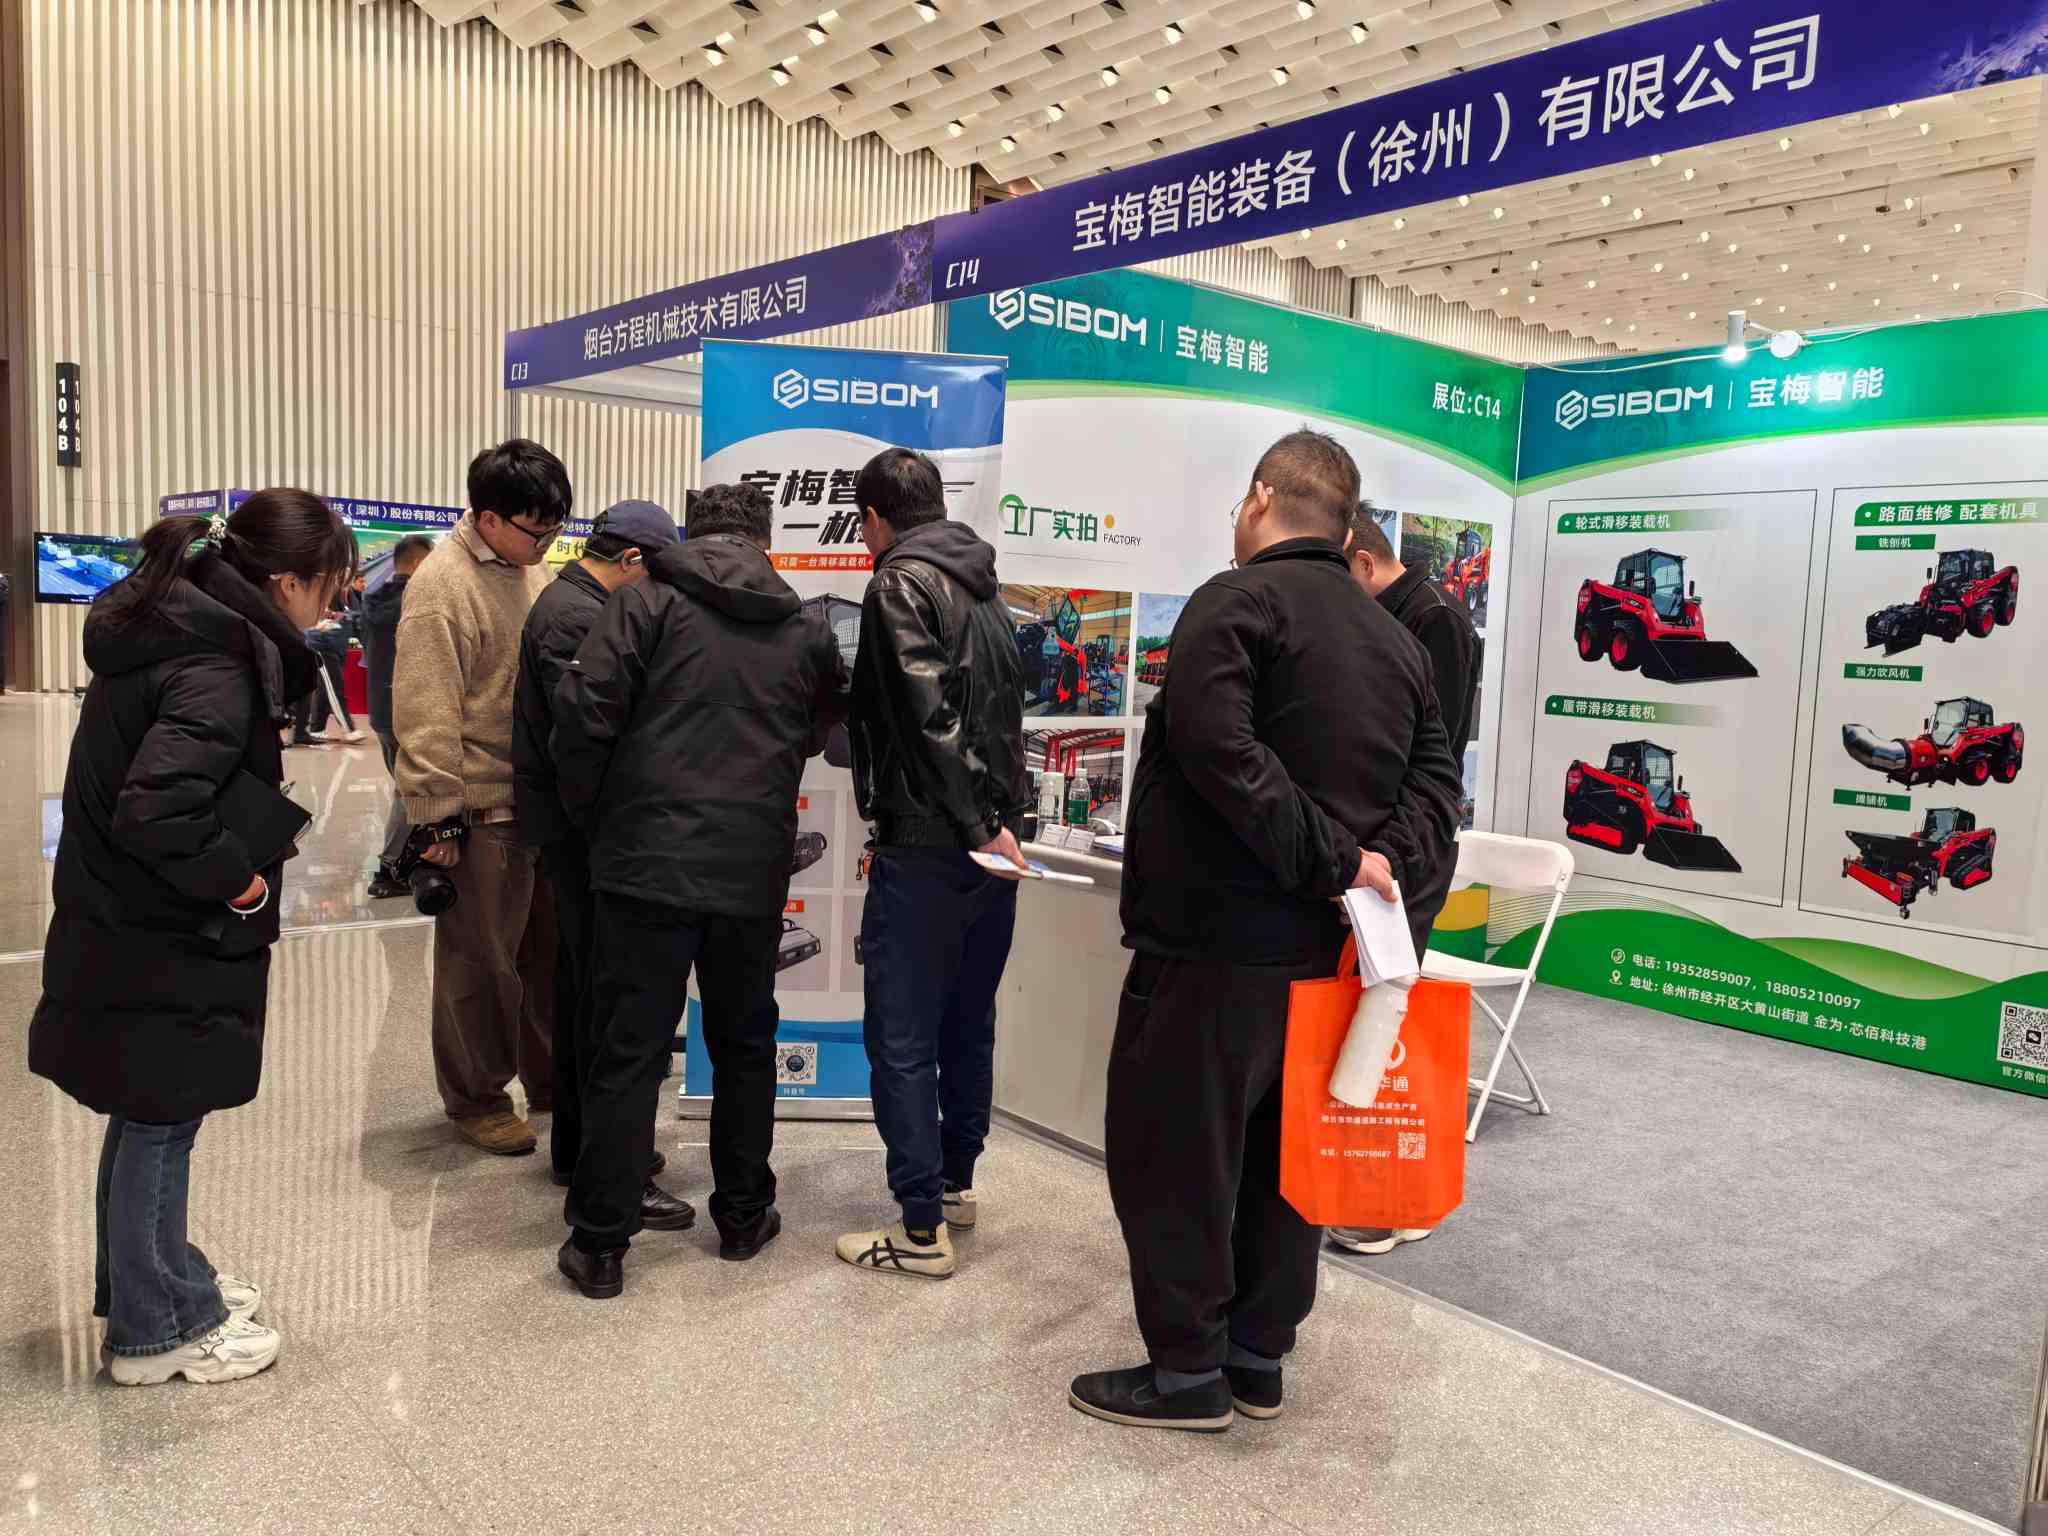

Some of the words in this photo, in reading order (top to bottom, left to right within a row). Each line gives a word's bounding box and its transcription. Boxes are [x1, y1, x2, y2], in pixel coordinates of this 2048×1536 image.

[1072, 14, 1821, 251] 宝梅智能装备（徐州）有限公司
[945, 258, 980, 289] C14
[584, 275, 808, 361] 烟台方程机械技术有限公司
[1028, 293, 1147, 346] SIBOM
[1175, 325, 1269, 374] 宝梅智能
[511, 362, 528, 382] C13
[812, 378, 939, 409] SIBOM
[1591, 384, 1713, 419] SIBOM
[1747, 366, 1885, 408] 宝梅智能
[57, 377, 69, 451] 104B
[782, 510, 866, 546] 一机
[1004, 504, 1098, 542] 工厂实拍
[1575, 514, 1671, 530] 轮式滑移装载机
[1877, 504, 1953, 523] 路面维修
[1959, 502, 2039, 521] 配套机具
[1103, 533, 1142, 546] FACTORY
[1562, 699, 1656, 720] 履带滑移装载机
[1662, 982, 1809, 1026] 徐州市经开区大黄山街道
[2002, 1065, 2048, 1086] 官方微信
